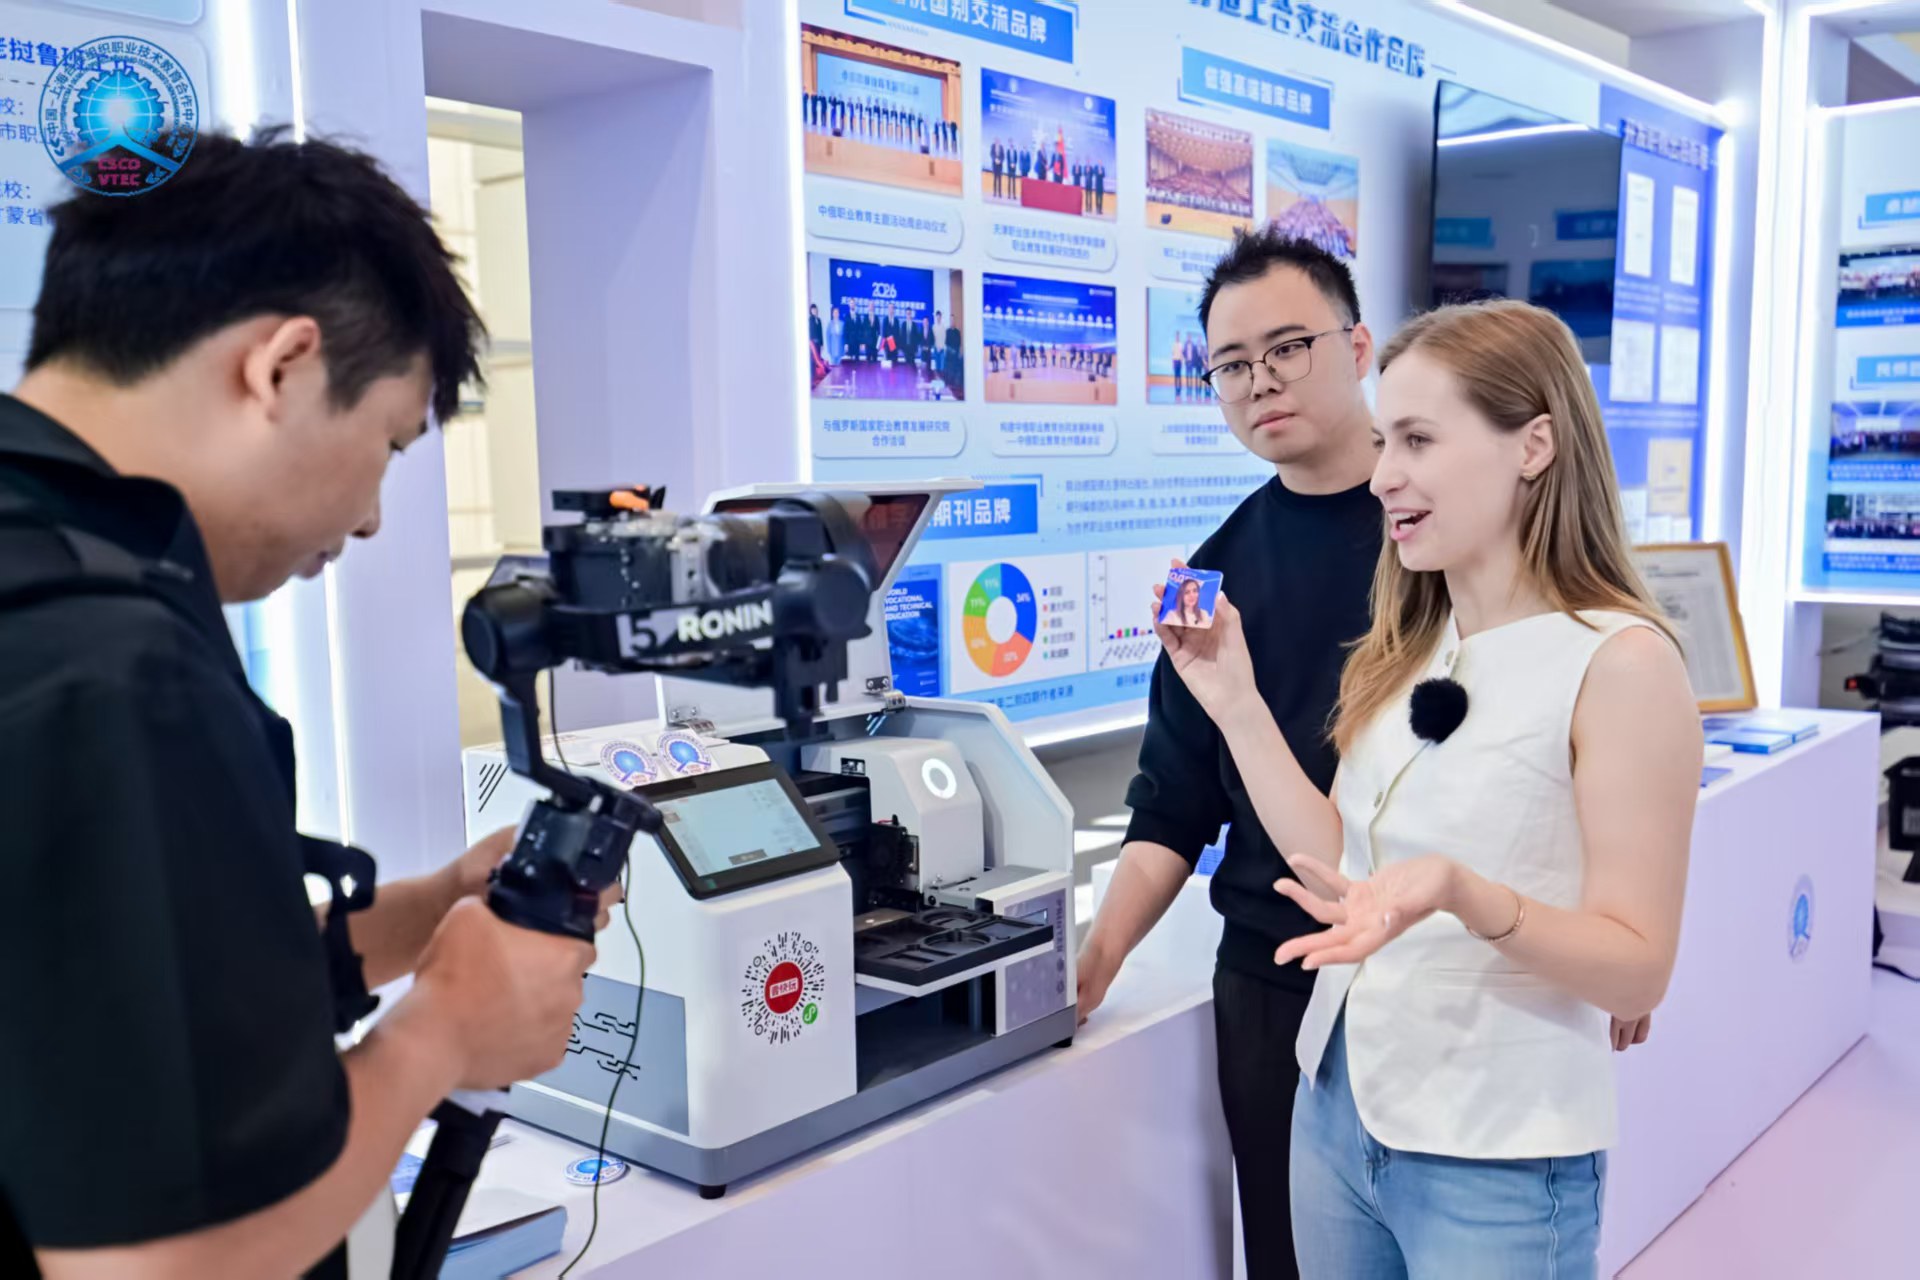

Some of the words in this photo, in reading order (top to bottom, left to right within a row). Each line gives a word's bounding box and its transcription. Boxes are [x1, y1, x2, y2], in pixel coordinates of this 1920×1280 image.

[896, 0, 1047, 43] 国别交流品牌
[1187, 0, 1425, 78] 上合交流合作品牌
[928, 497, 1012, 527] 期刊品牌
[677, 598, 773, 641] RONIN
